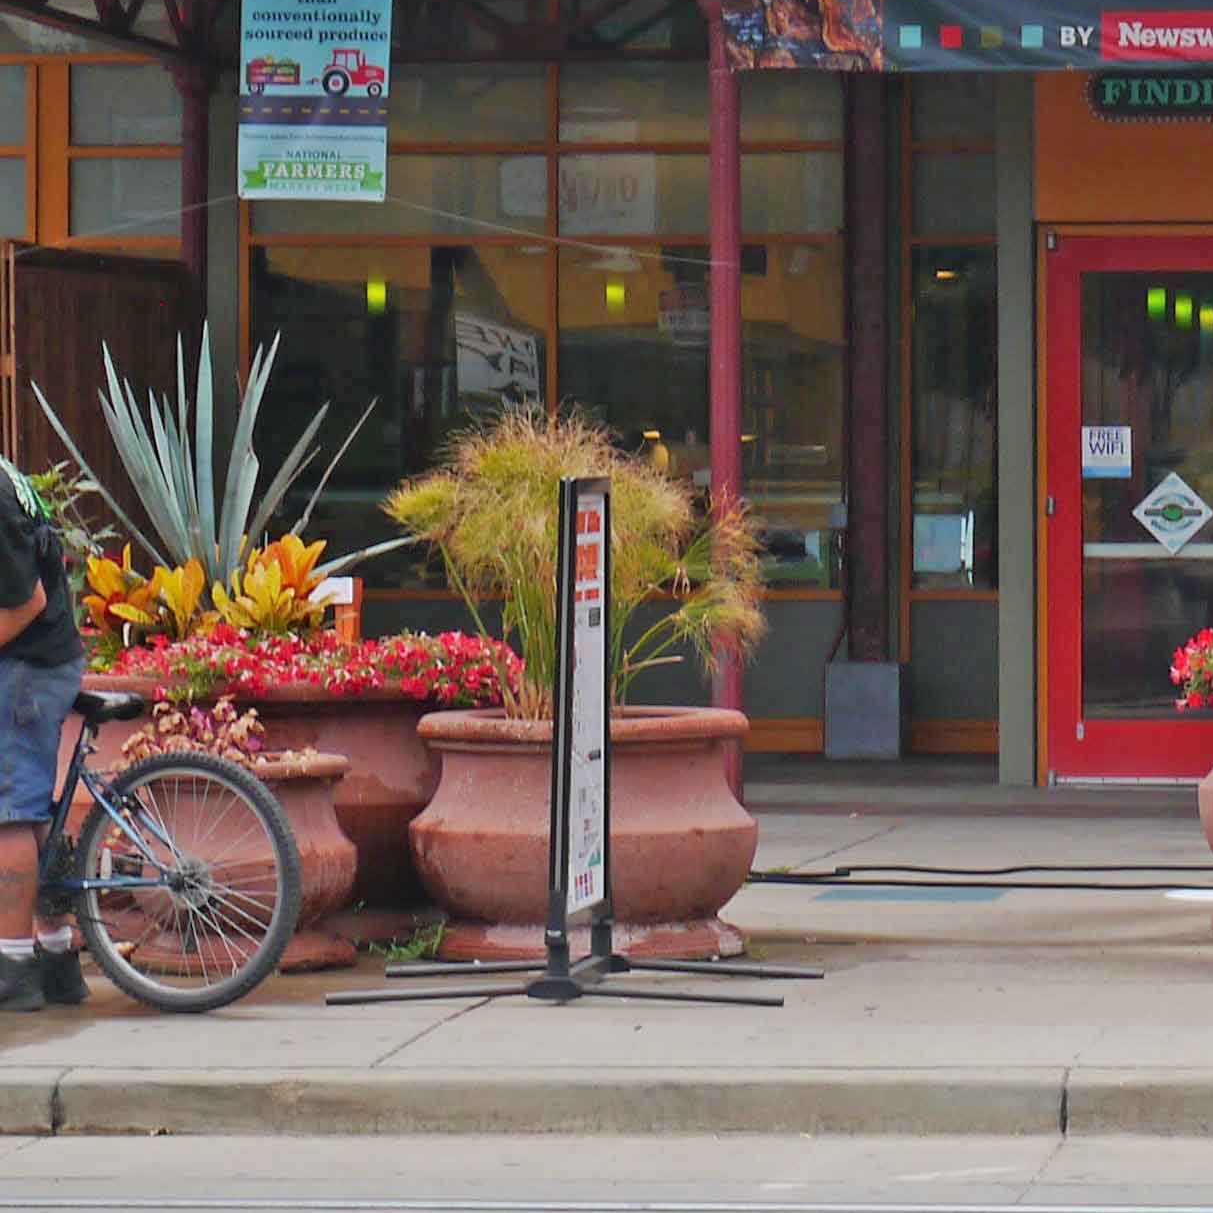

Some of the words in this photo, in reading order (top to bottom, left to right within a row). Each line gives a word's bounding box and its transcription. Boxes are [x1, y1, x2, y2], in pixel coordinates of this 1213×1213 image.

[251, 9, 382, 25] conventionally
[245, 28, 313, 42] sourced
[318, 28, 388, 45] produce
[1060, 26, 1095, 47] BY
[286, 149, 342, 160] NATIONAL
[263, 162, 366, 180] FARMERS
[1089, 442, 1124, 455] WIFI
